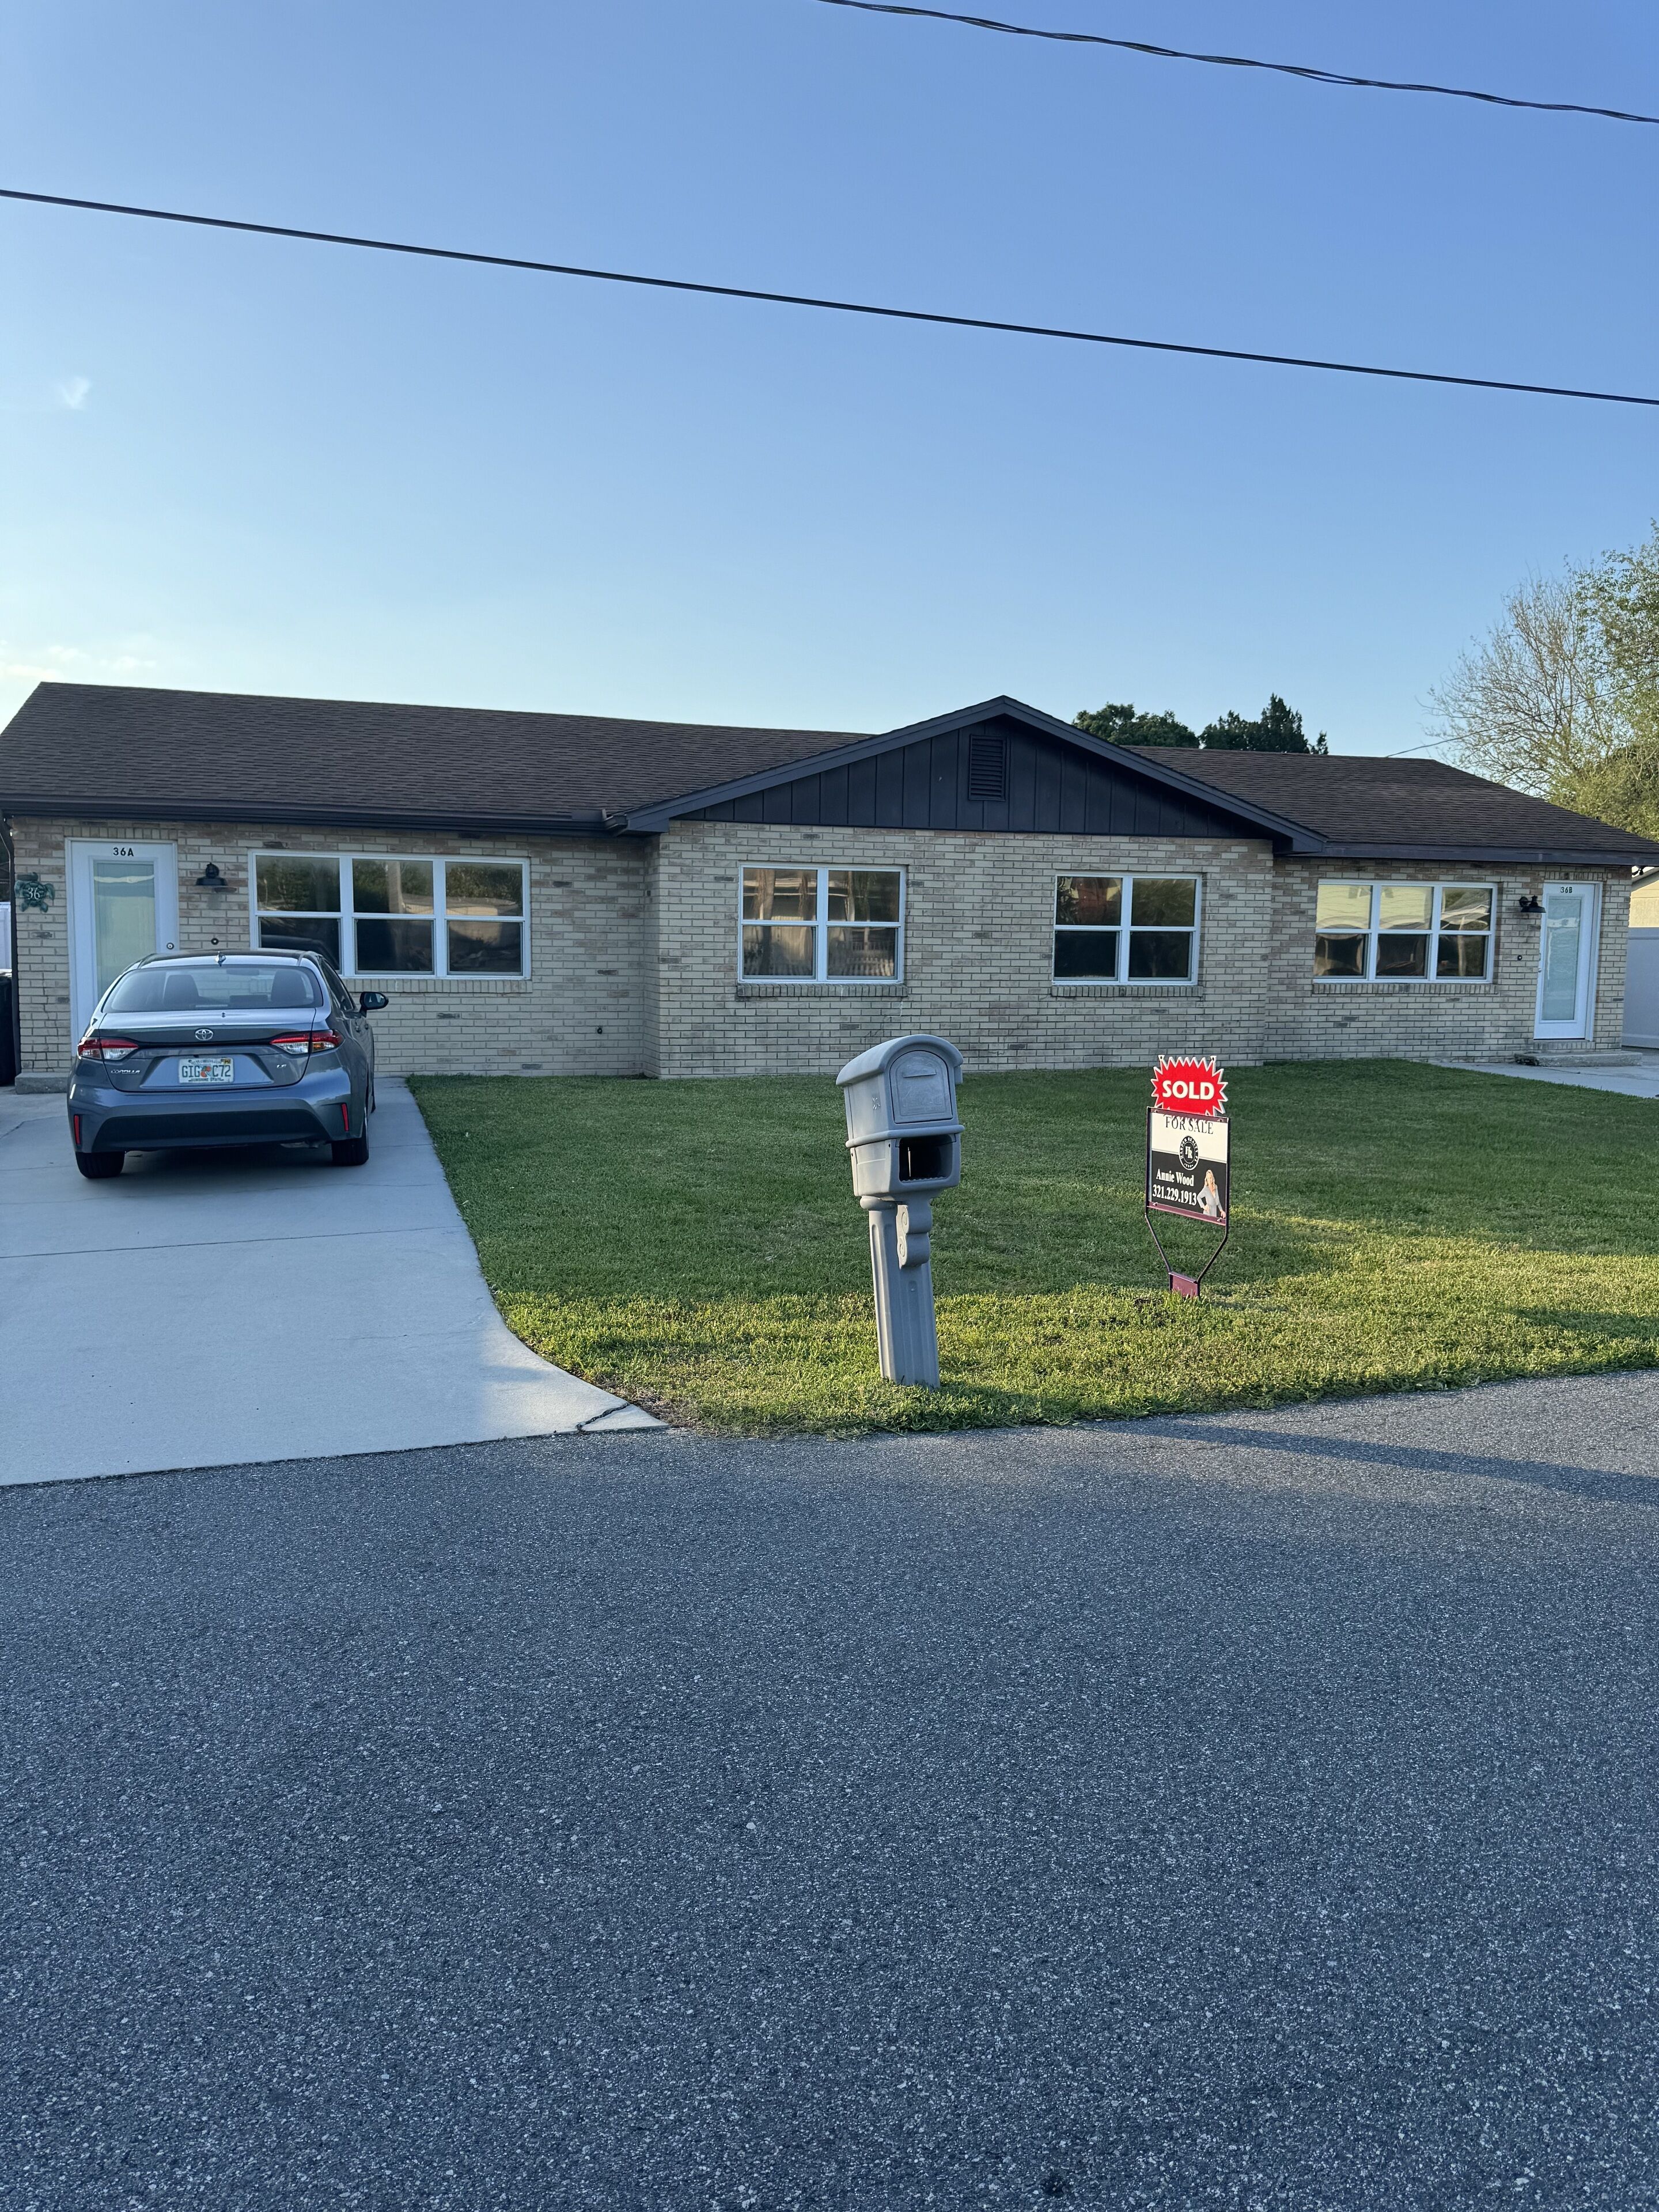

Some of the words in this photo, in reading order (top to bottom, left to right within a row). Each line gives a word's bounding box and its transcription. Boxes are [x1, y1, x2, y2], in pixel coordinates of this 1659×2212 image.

[113, 847, 134, 857] 36A
[28, 887, 40, 900] 36
[1162, 1080, 1215, 1100] SOLD
[1165, 1115, 1185, 1131] FOR
[1188, 1119, 1214, 1135] SALE
[1156, 1168, 1175, 1183] Annie
[1175, 1171, 1194, 1187] Wood
[1152, 1184, 1197, 1206] 321.229.1913
